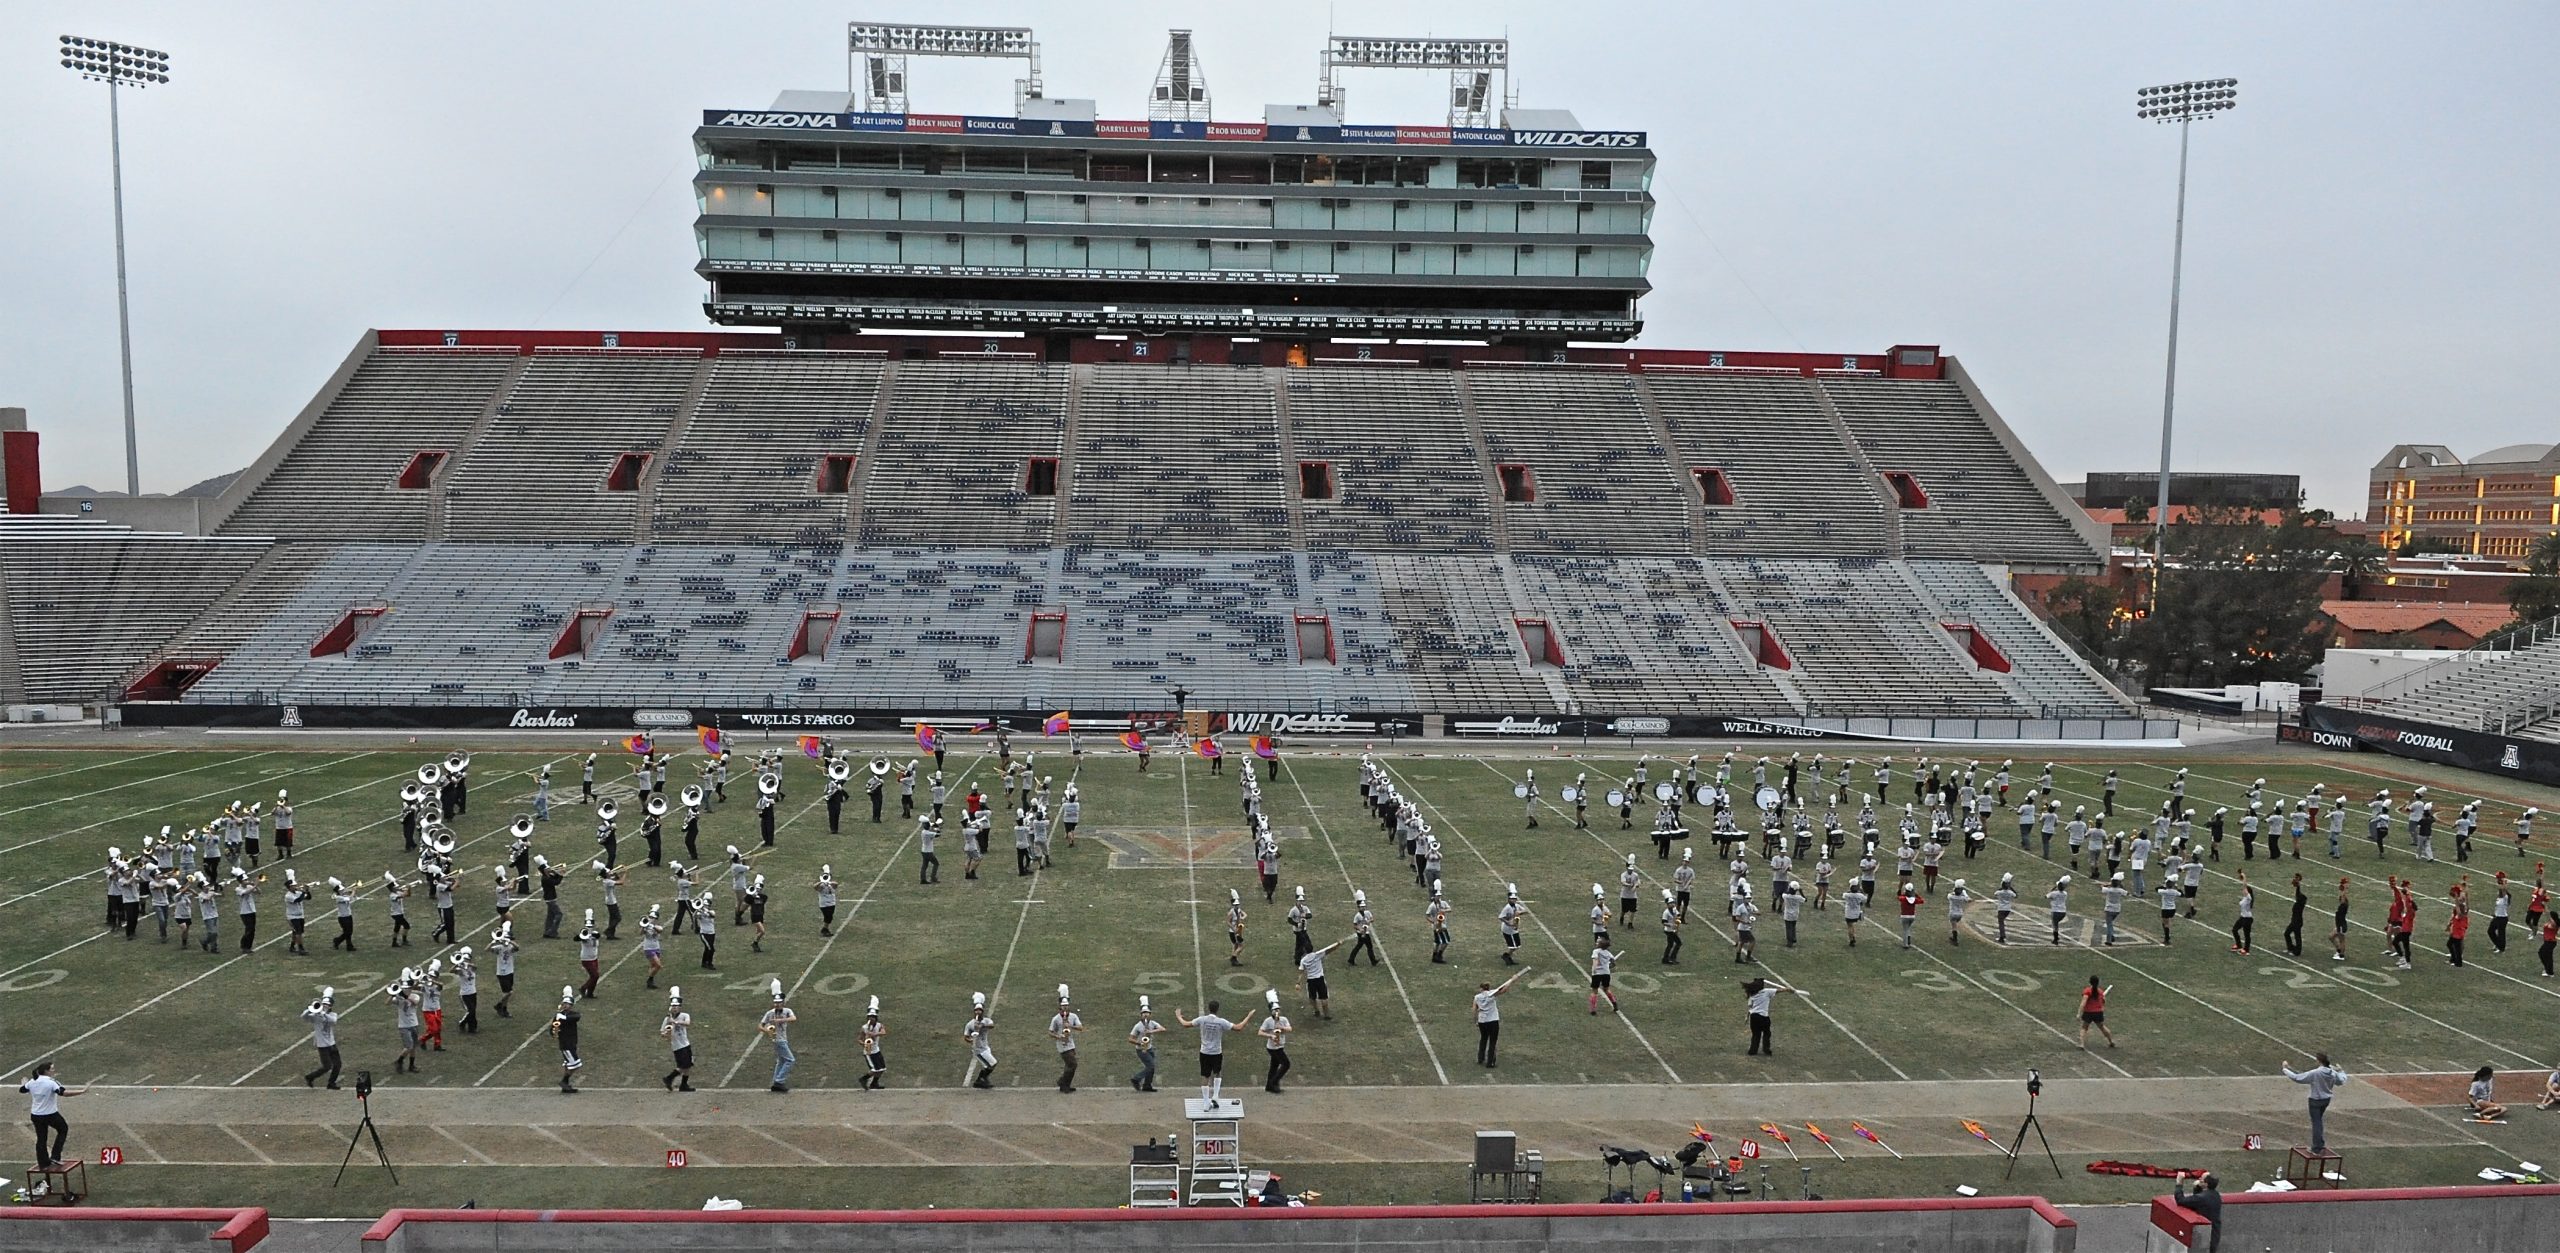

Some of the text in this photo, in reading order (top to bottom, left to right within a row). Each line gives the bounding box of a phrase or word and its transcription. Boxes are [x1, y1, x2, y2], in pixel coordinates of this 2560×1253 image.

[717, 113, 837, 128] ARIZONA
[852, 116, 861, 124] 22
[875, 118, 903, 126] LUPPINO
[916, 119, 935, 127] RICKY
[937, 120, 961, 128] HUNLEY
[973, 121, 996, 129] CHUCK
[996, 121, 1015, 129] CECIL
[1095, 124, 1100, 132] 4
[1100, 125, 1129, 133] DARRYLL
[1215, 127, 1229, 135] ROB
[1453, 131, 1506, 141] 5 ANTOINE CASON
[1514, 132, 1639, 147] WILDCATS
[445, 336, 456, 346] 17
[604, 338, 616, 348] 18
[784, 340, 796, 350] 19
[984, 344, 998, 352] 20
[1135, 346, 1147, 355] 21
[1358, 350, 1371, 360] 22
[1553, 354, 1566, 363] 23
[1710, 358, 1723, 367] 24
[1844, 361, 1856, 370] 25
[81, 502, 92, 511] 16
[509, 708, 578, 727] Bashas'
[747, 714, 855, 725] WELLS FARGO
[1722, 722, 1772, 733] WELLS
[2313, 731, 2352, 748] DOWN
[2396, 731, 2453, 751] FOOTBALL
[1131, 973, 1270, 995] 50
[1206, 1140, 1221, 1154] 50
[2247, 1135, 2261, 1150] 30
[1741, 1140, 1756, 1157] 40
[102, 1148, 118, 1164] 30
[669, 1151, 685, 1167] 40
